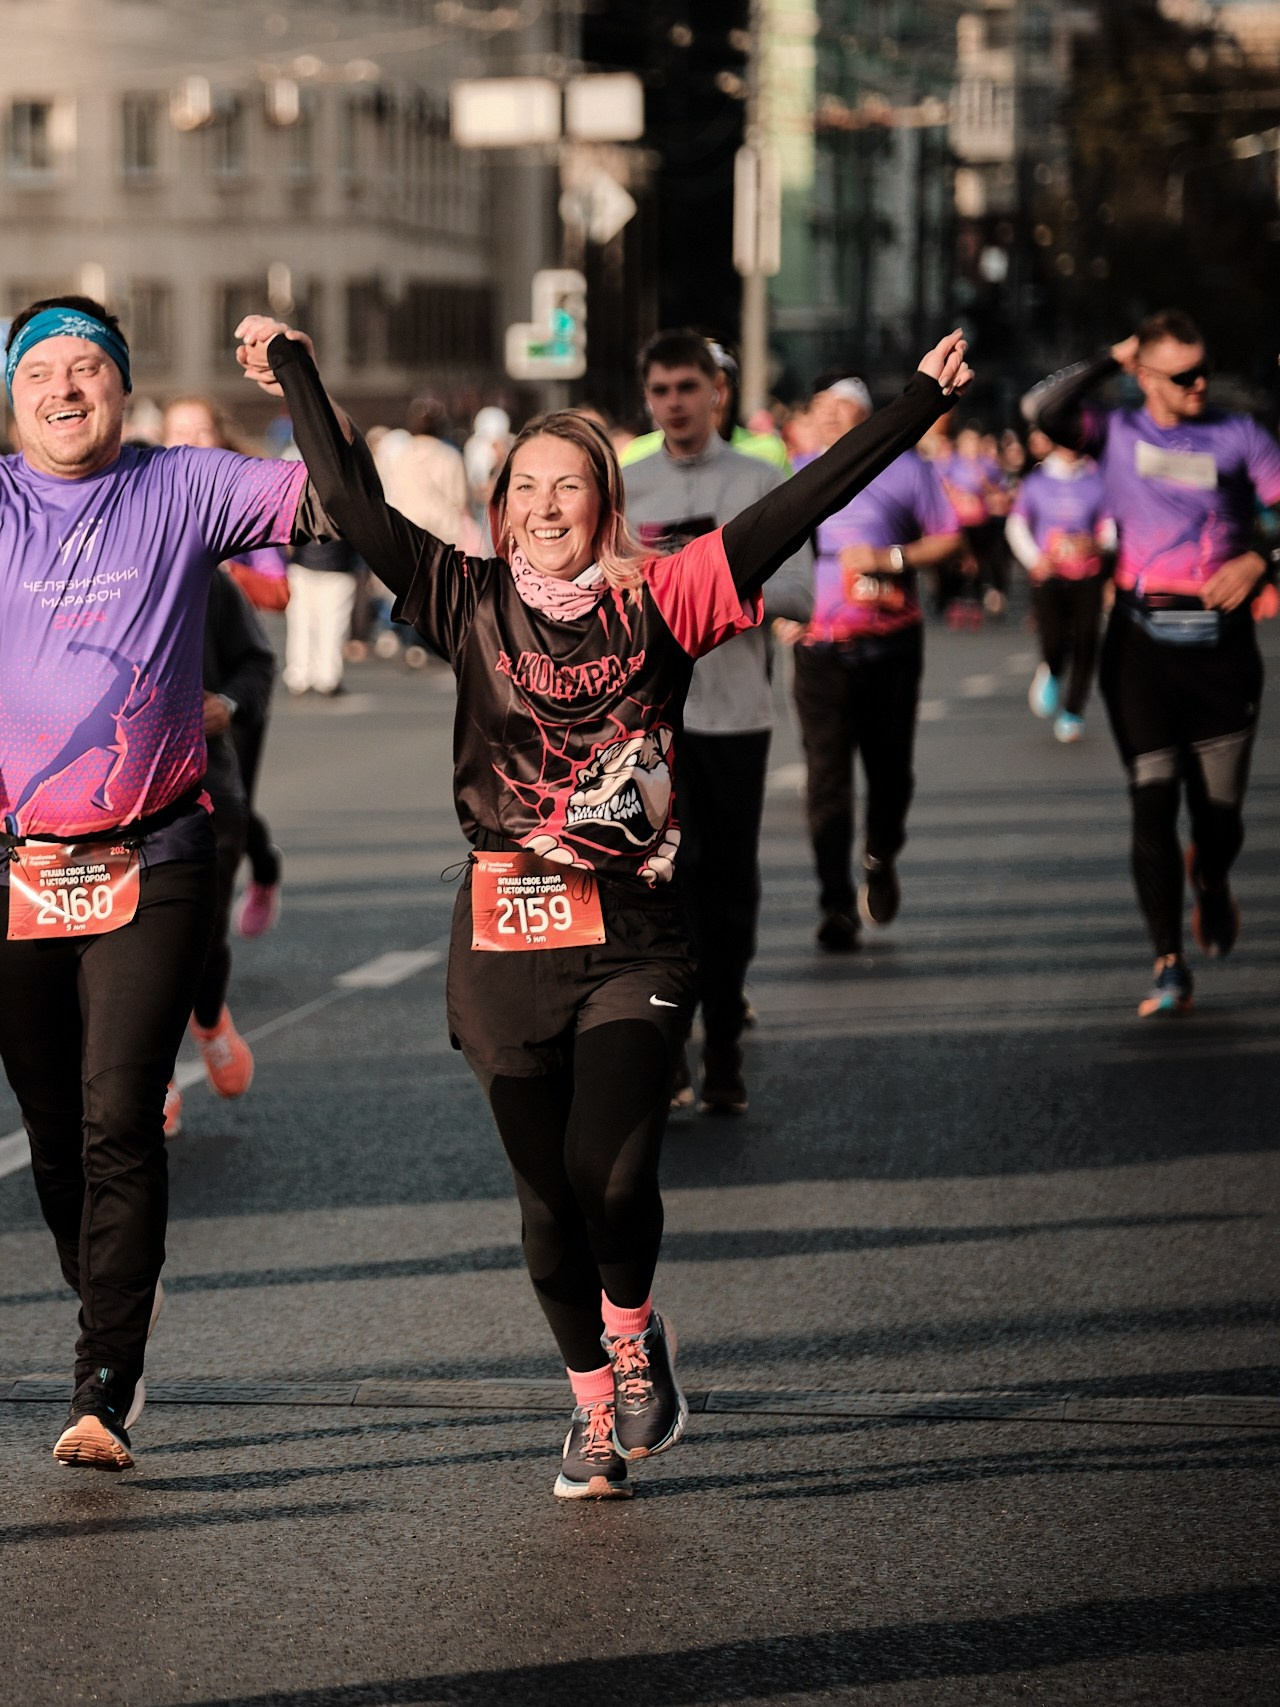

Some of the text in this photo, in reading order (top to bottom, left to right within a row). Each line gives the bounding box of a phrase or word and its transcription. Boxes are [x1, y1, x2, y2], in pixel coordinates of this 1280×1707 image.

[23, 566, 139, 593] ЧЕЛЯБИНСКИЙ
[41, 588, 121, 608] МАРАФОН
[52, 610, 108, 631] 2024
[66, 866, 85, 876] СВОЕ
[86, 864, 106, 874] ИМЯ
[40, 873, 111, 887] В ИСТОРИЮ ГОРОДА
[522, 876, 541, 885] СВОЕ
[542, 874, 562, 884] ИМЯ
[497, 883, 568, 894] В ИСТОРИЮ ГОРОДА
[36, 884, 113, 925] 2160
[496, 895, 572, 934] 2159
[526, 934, 532, 943] 5
